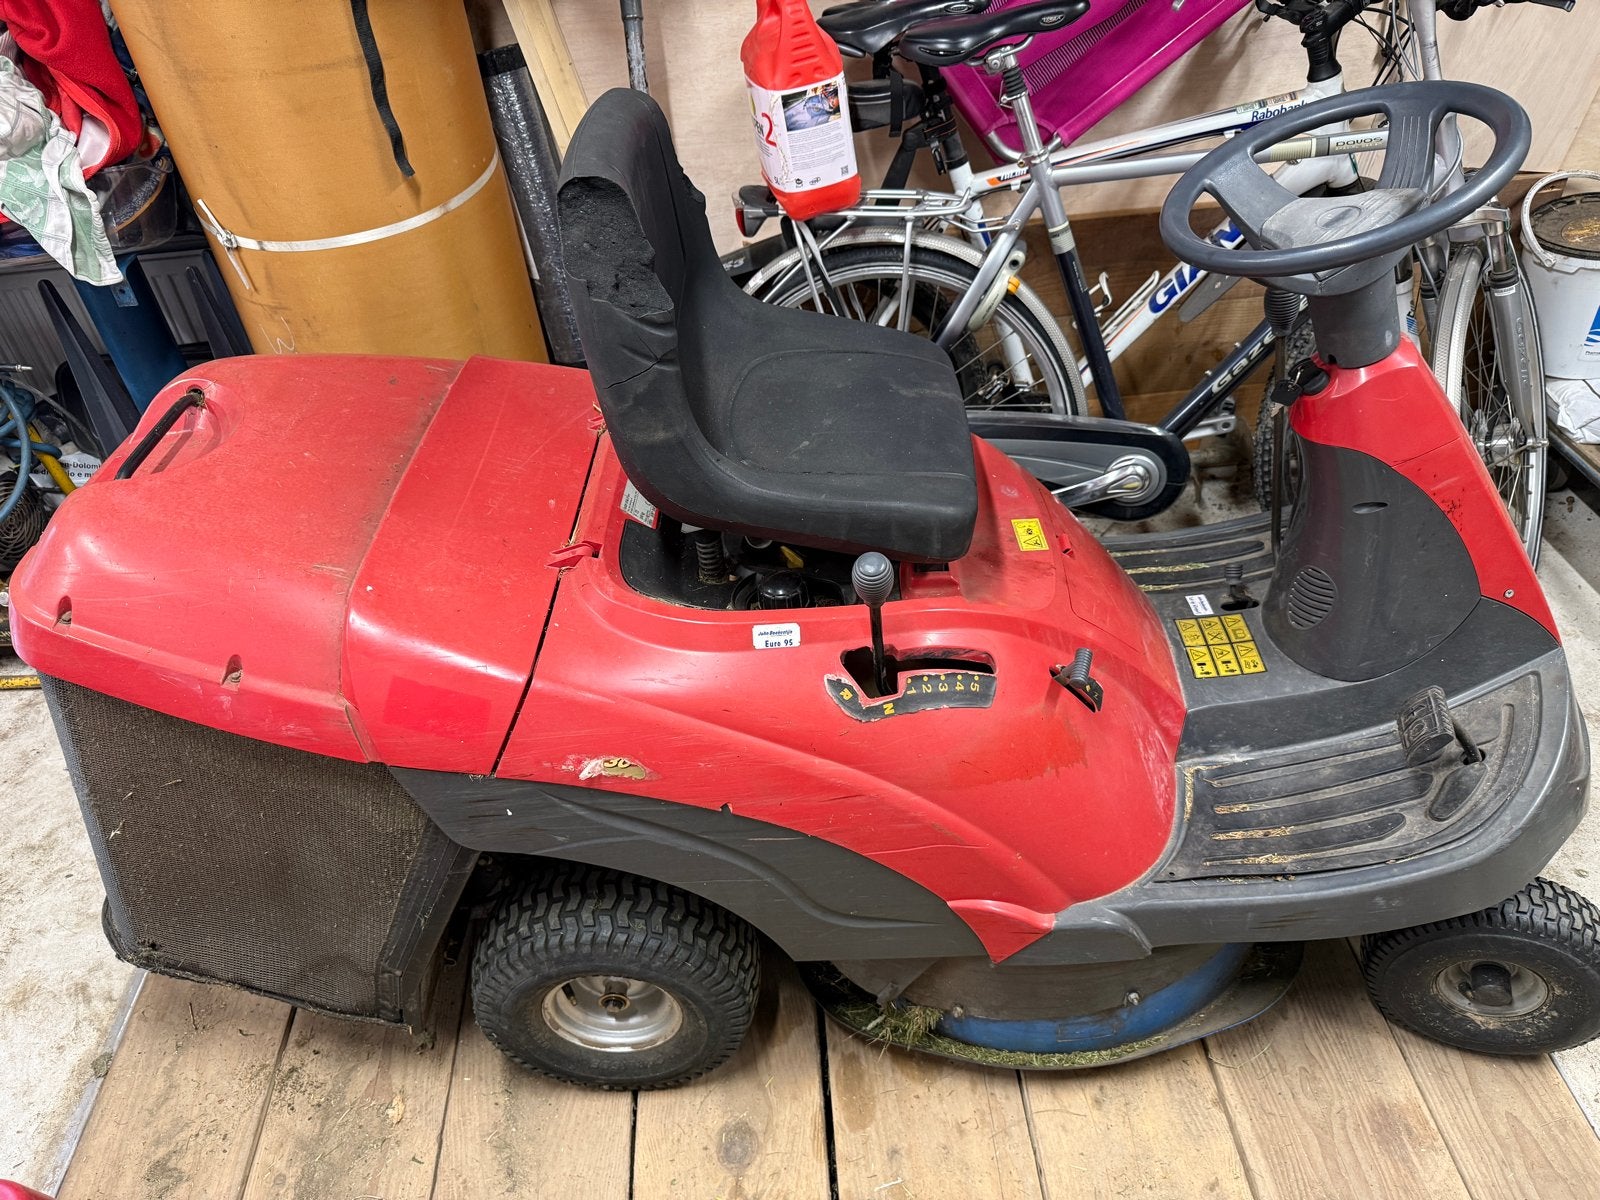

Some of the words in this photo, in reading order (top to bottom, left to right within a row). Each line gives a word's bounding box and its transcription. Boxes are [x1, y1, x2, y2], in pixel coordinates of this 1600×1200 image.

[761, 112, 778, 148] 2
[1211, 294, 1309, 395] Gazee
[764, 639, 781, 648] Euro
[783, 638, 793, 647] 95
[839, 687, 853, 701] R
[882, 702, 895, 715] N
[906, 686, 917, 695] 1
[922, 683, 933, 693] 2
[938, 682, 949, 693] 3
[954, 681, 965, 692] 4
[969, 681, 980, 692] 5
